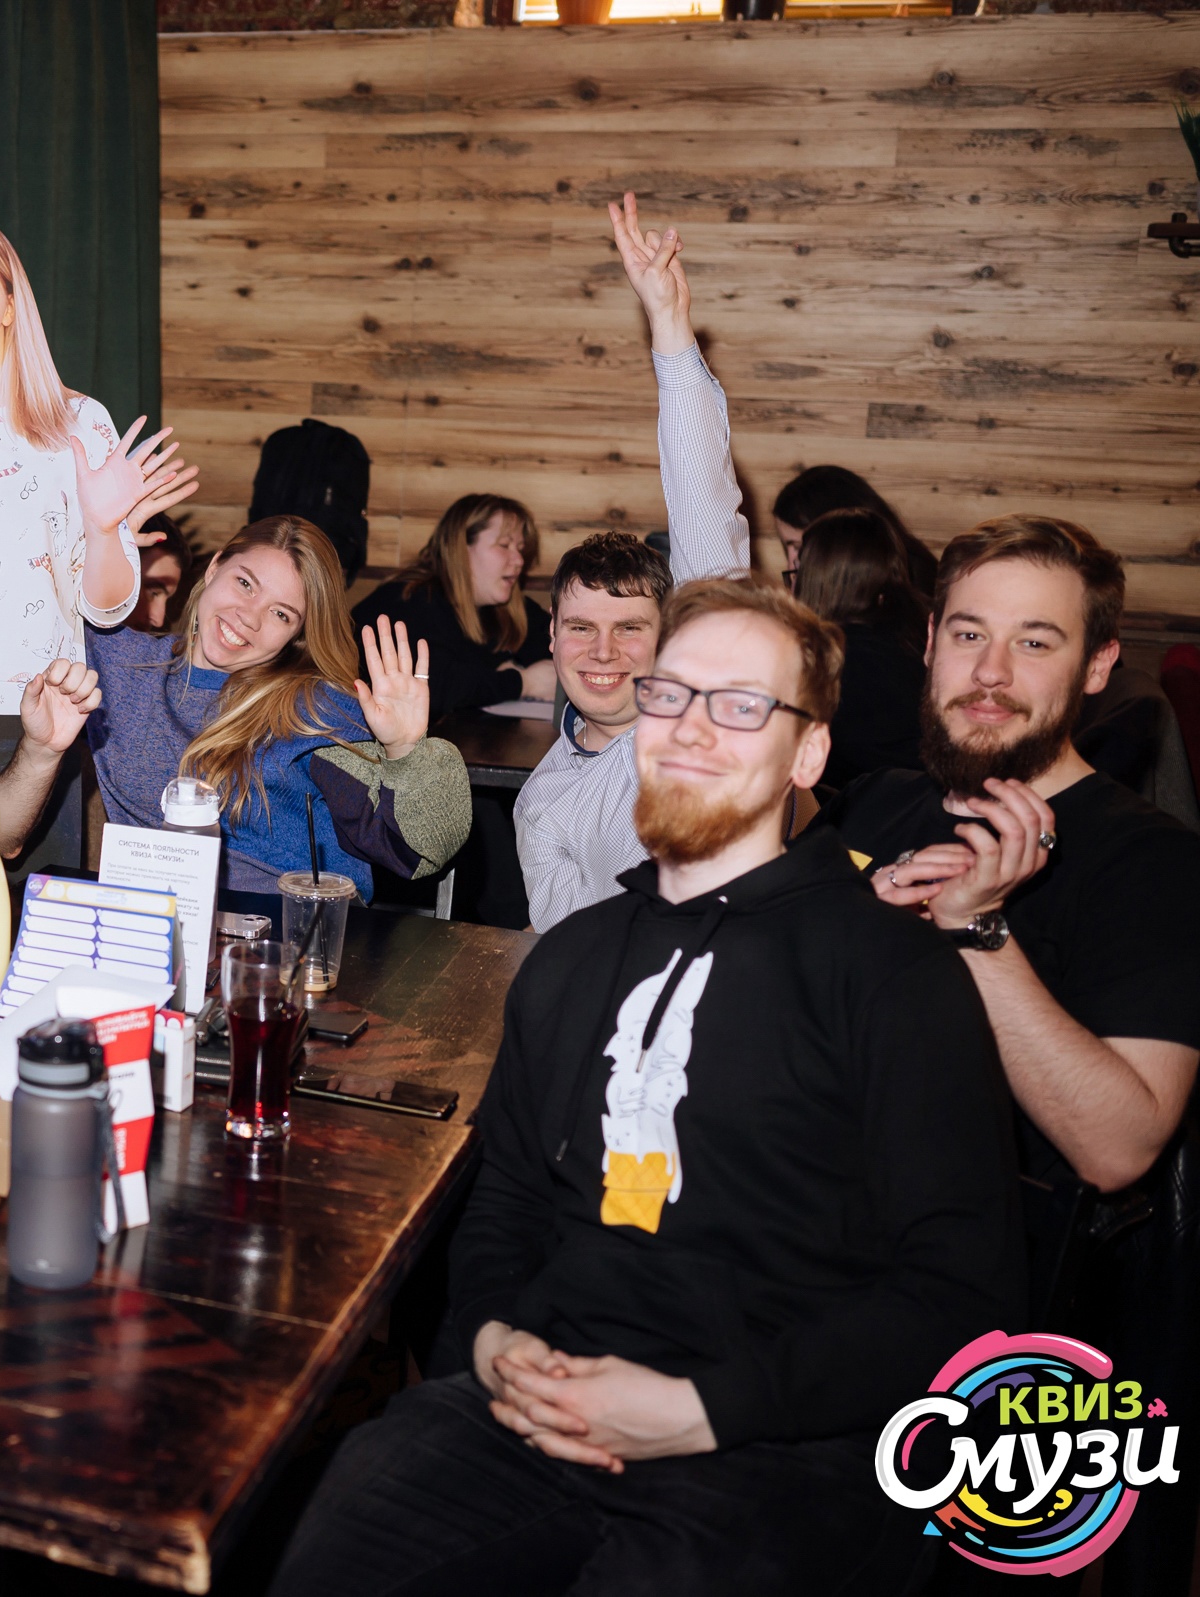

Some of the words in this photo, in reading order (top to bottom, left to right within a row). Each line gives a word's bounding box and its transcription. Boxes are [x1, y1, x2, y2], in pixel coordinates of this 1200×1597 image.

[118, 839, 151, 849] СИСТЕМА
[152, 844, 200, 856] ЛОЯЛЬНОСТИ
[130, 850, 152, 859] КВИЗА
[153, 854, 185, 863] «СМУЗИ»
